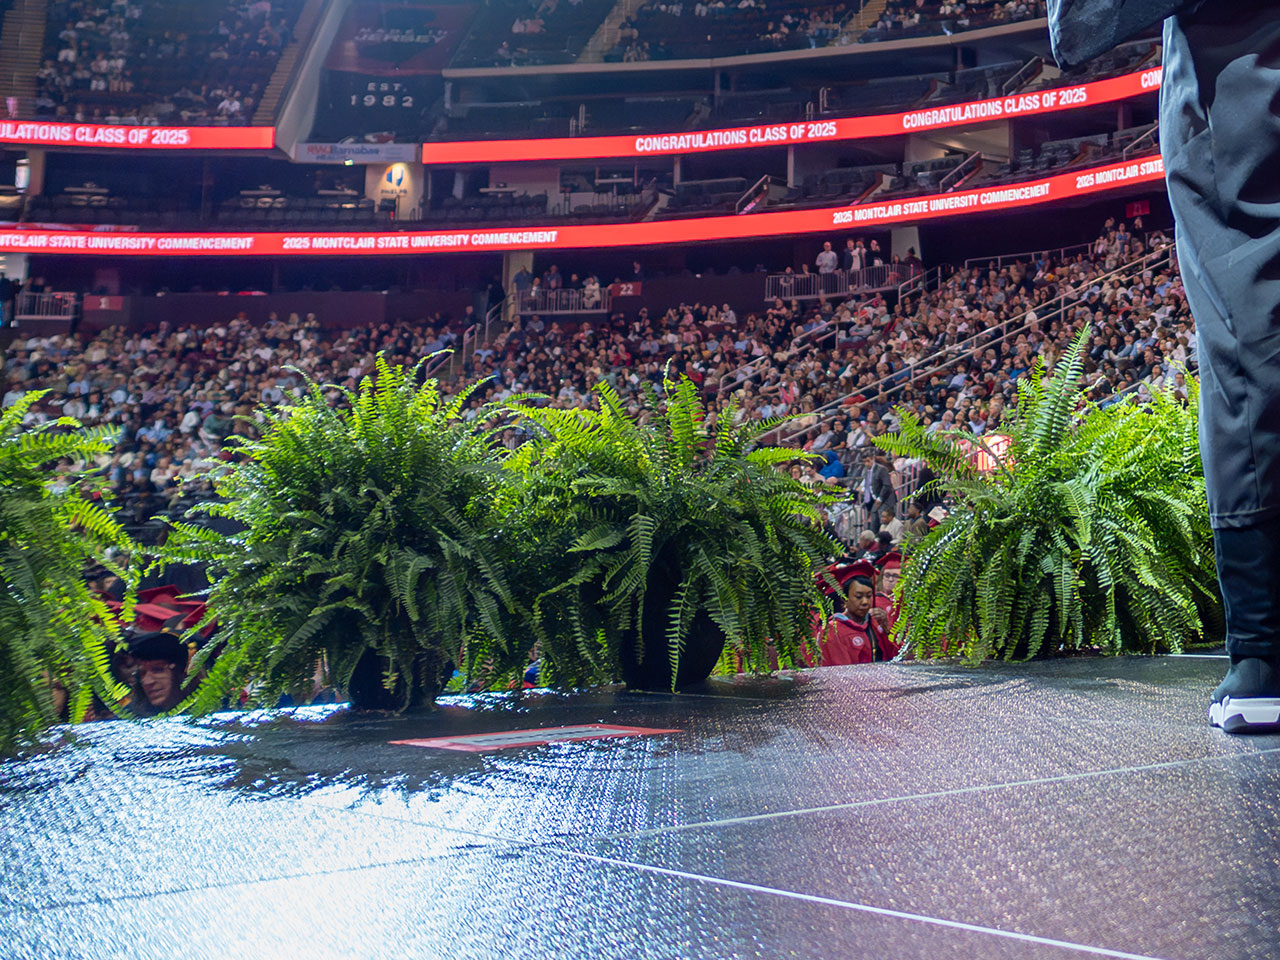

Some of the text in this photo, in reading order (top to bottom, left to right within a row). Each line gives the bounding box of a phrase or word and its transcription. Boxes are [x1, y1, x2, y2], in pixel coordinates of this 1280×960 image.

[350, 95, 414, 108] 1982
[903, 87, 1087, 129] CONGRATULATIONS CLASS OF 2025
[75, 125, 126, 144] CLASS
[128, 128, 151, 145] OF
[151, 128, 190, 145] 2025
[635, 121, 837, 153] CONGRATULATIONS CLASS OF 2025
[1076, 158, 1164, 189] 2025 MONTCLAIR STATE
[833, 183, 1051, 224] 2025 MONTCLAIR STATE UNIVERSITY COMMENCEMENT
[49, 235, 86, 248] STATE
[87, 236, 155, 249] UNIVERSITY
[157, 237, 254, 250] COMMENCEMENT
[283, 231, 557, 249] 2025 MONTCLAIR STATE UNIVERSITY COMMENCEMENT
[620, 283, 633, 296] 22
